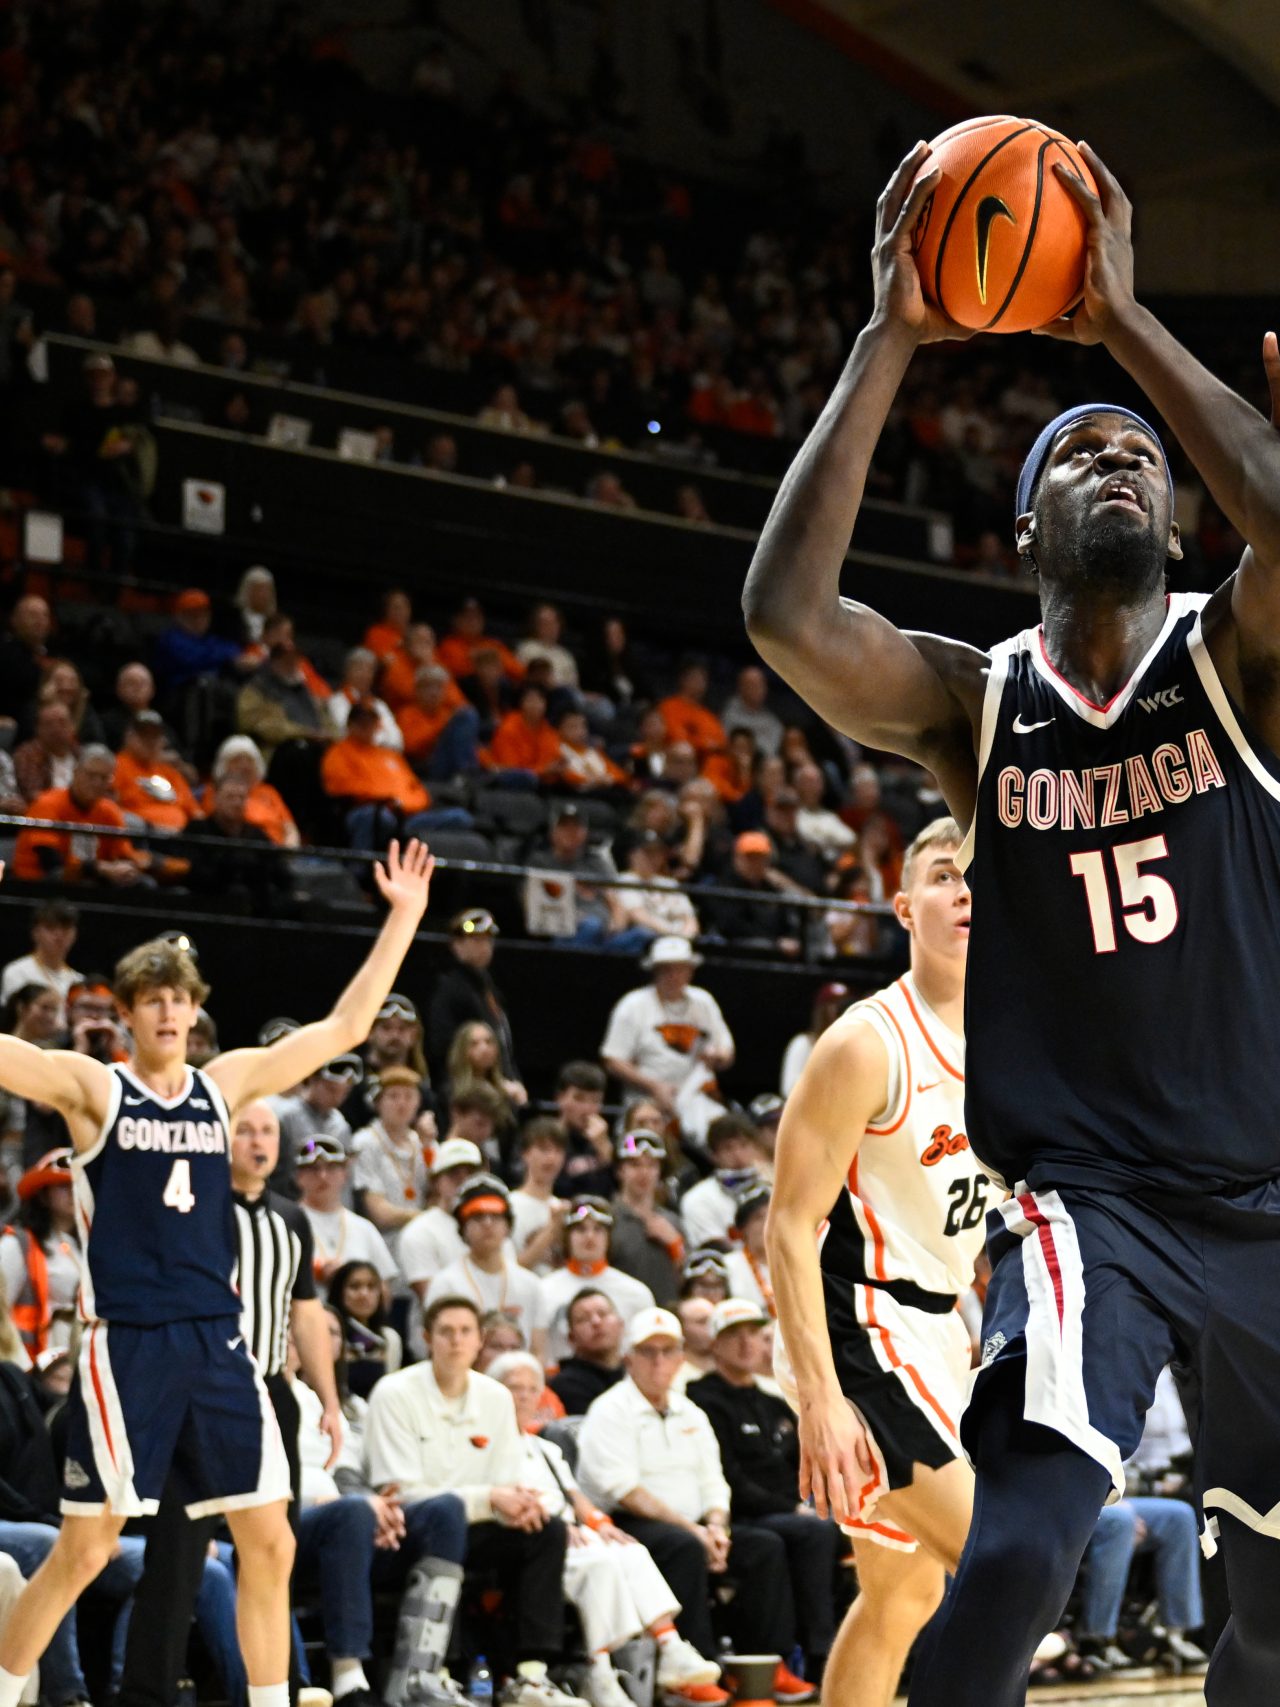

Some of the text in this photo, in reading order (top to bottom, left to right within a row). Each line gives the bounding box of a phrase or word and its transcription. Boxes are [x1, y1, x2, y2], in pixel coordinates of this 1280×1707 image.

[1137, 684, 1184, 714] WCC
[998, 729, 1227, 830] GONZAGA
[1069, 833, 1179, 954] 15
[163, 1159, 196, 1213] 4
[943, 1173, 990, 1237] 26
